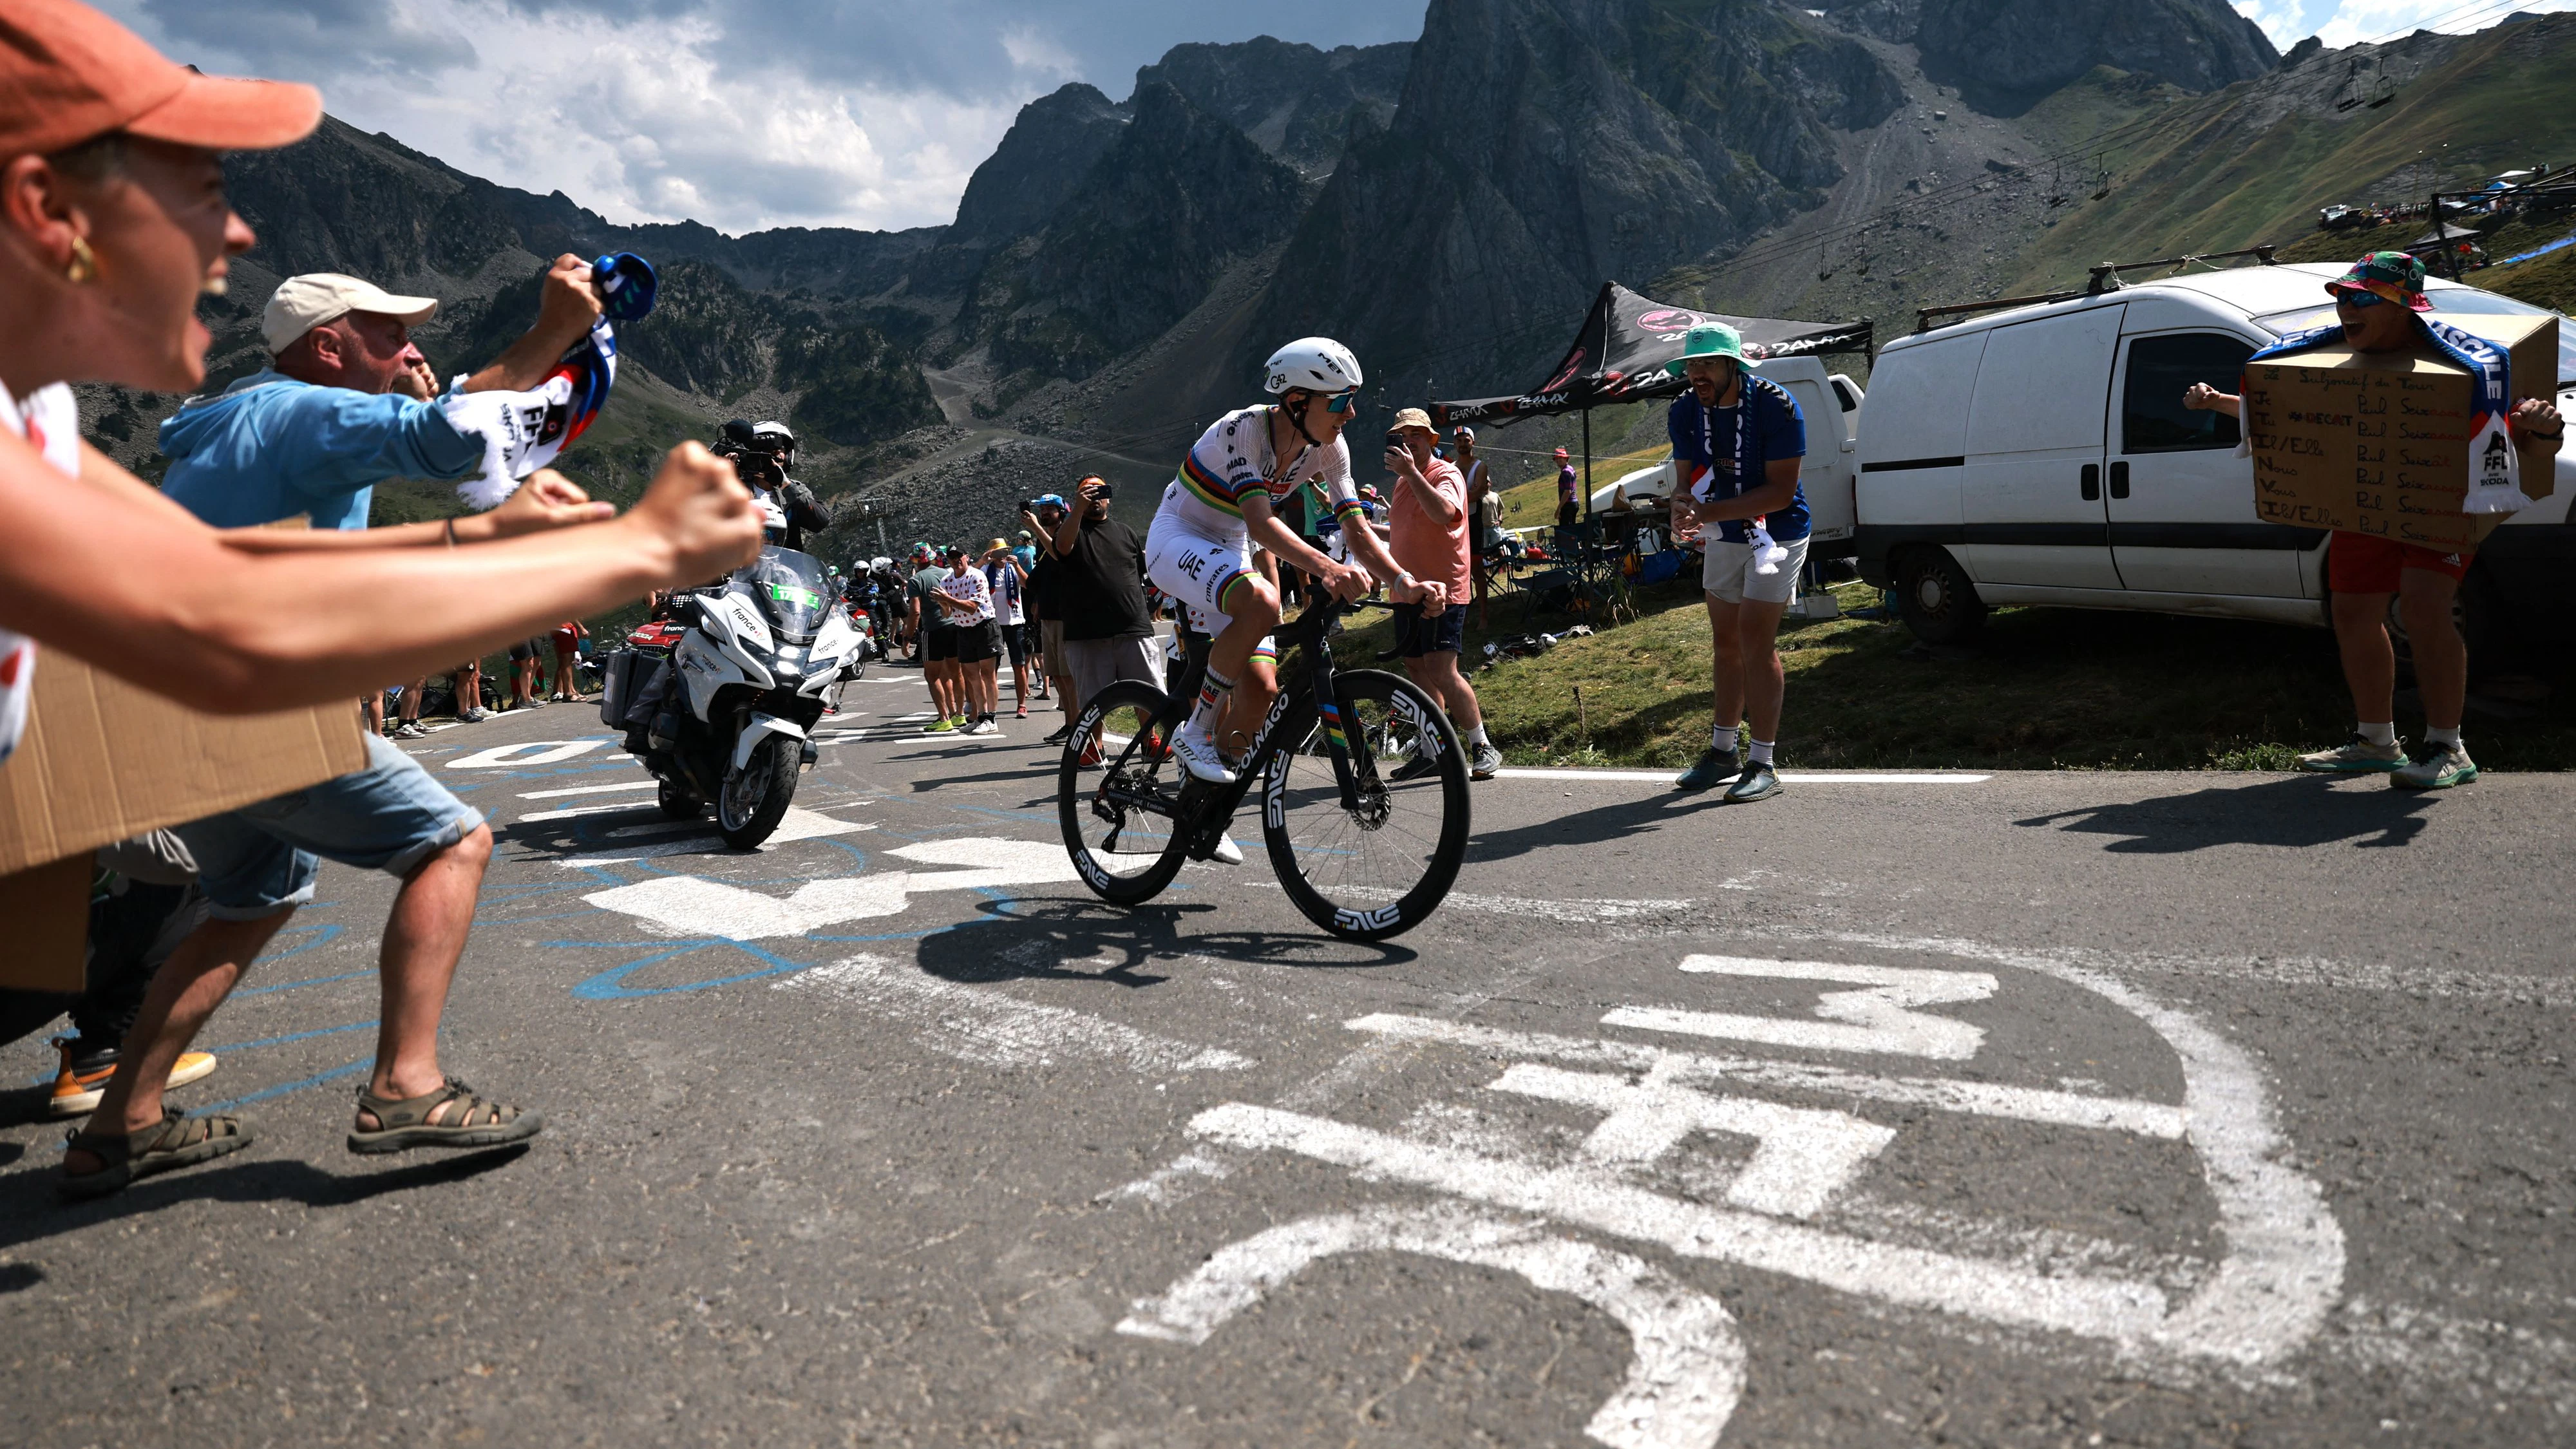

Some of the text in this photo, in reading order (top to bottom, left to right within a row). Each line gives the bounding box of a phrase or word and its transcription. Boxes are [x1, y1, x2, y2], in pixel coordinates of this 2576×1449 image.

[1318, 352, 1344, 375] MET
[1271, 374, 1287, 389] G42
[2299, 369, 2369, 392] Subjonctif
[2375, 375, 2391, 388] du
[2396, 377, 2436, 392] Tour
[2254, 391, 2271, 406] Je
[2358, 394, 2387, 415] Paul
[2255, 412, 2276, 426] Tu
[2358, 419, 2387, 439] Paul
[2253, 433, 2324, 457] Il/Elle
[2358, 444, 2385, 463] Paul
[2257, 456, 2298, 476] Nous
[2357, 468, 2385, 486] Paul
[2484, 455, 2507, 471] FFL
[2259, 478, 2297, 498] Vous
[2357, 491, 2384, 511] Paul
[2359, 515, 2389, 536] Paul
[1178, 549, 1206, 582] UAE
[1206, 563, 1229, 603] Emirates
[1202, 681, 1220, 697] UAE
[1070, 704, 1101, 752] ENVE
[1391, 689, 1446, 755] ENVE
[1235, 692, 1289, 781] COLNAGO
[1267, 749, 1290, 829] ENVE
[1133, 798, 1143, 806] UAE
[1146, 802, 1166, 813] Emirates
[1075, 849, 1110, 890] ENVE
[1334, 904, 1401, 931] ENVE
